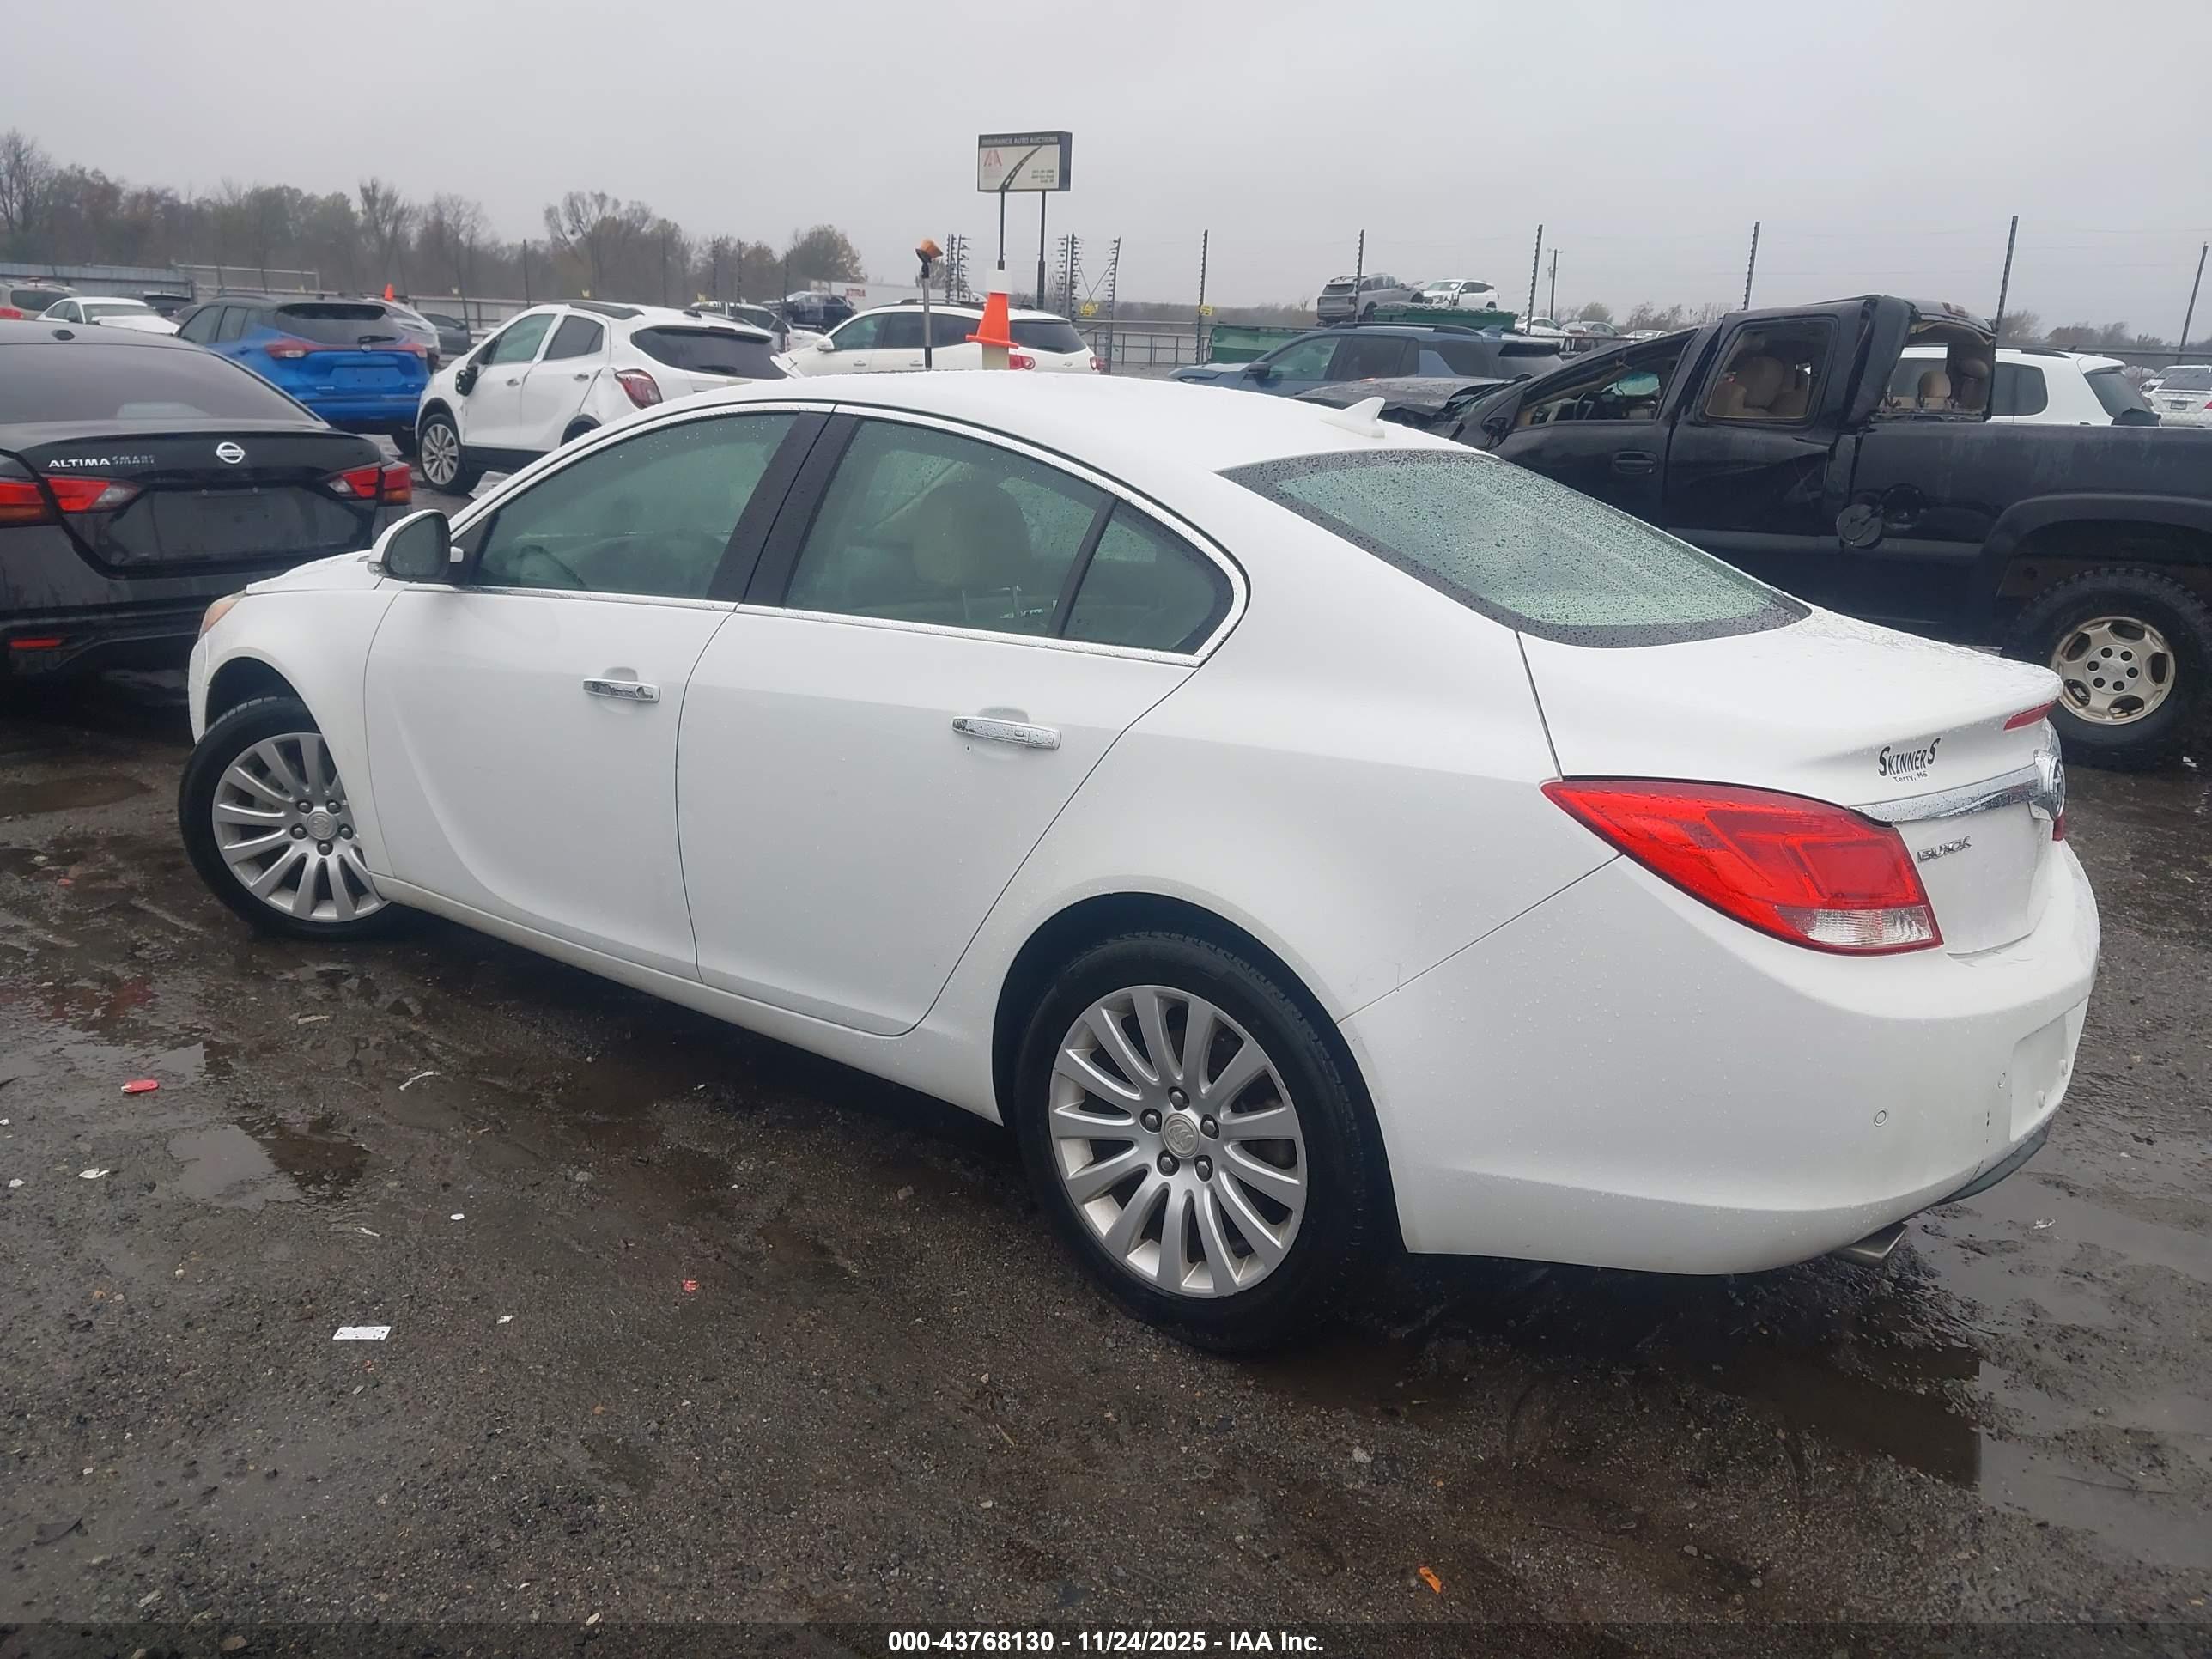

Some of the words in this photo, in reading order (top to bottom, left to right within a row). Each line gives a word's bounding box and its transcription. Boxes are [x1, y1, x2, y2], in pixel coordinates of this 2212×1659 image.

[1030, 136, 1058, 144] AUCTIONS
[48, 458, 111, 468] ALTIMA
[112, 454, 155, 465] SMART
[1878, 738, 1941, 776] SKINNERS
[1917, 770, 1928, 779] MS
